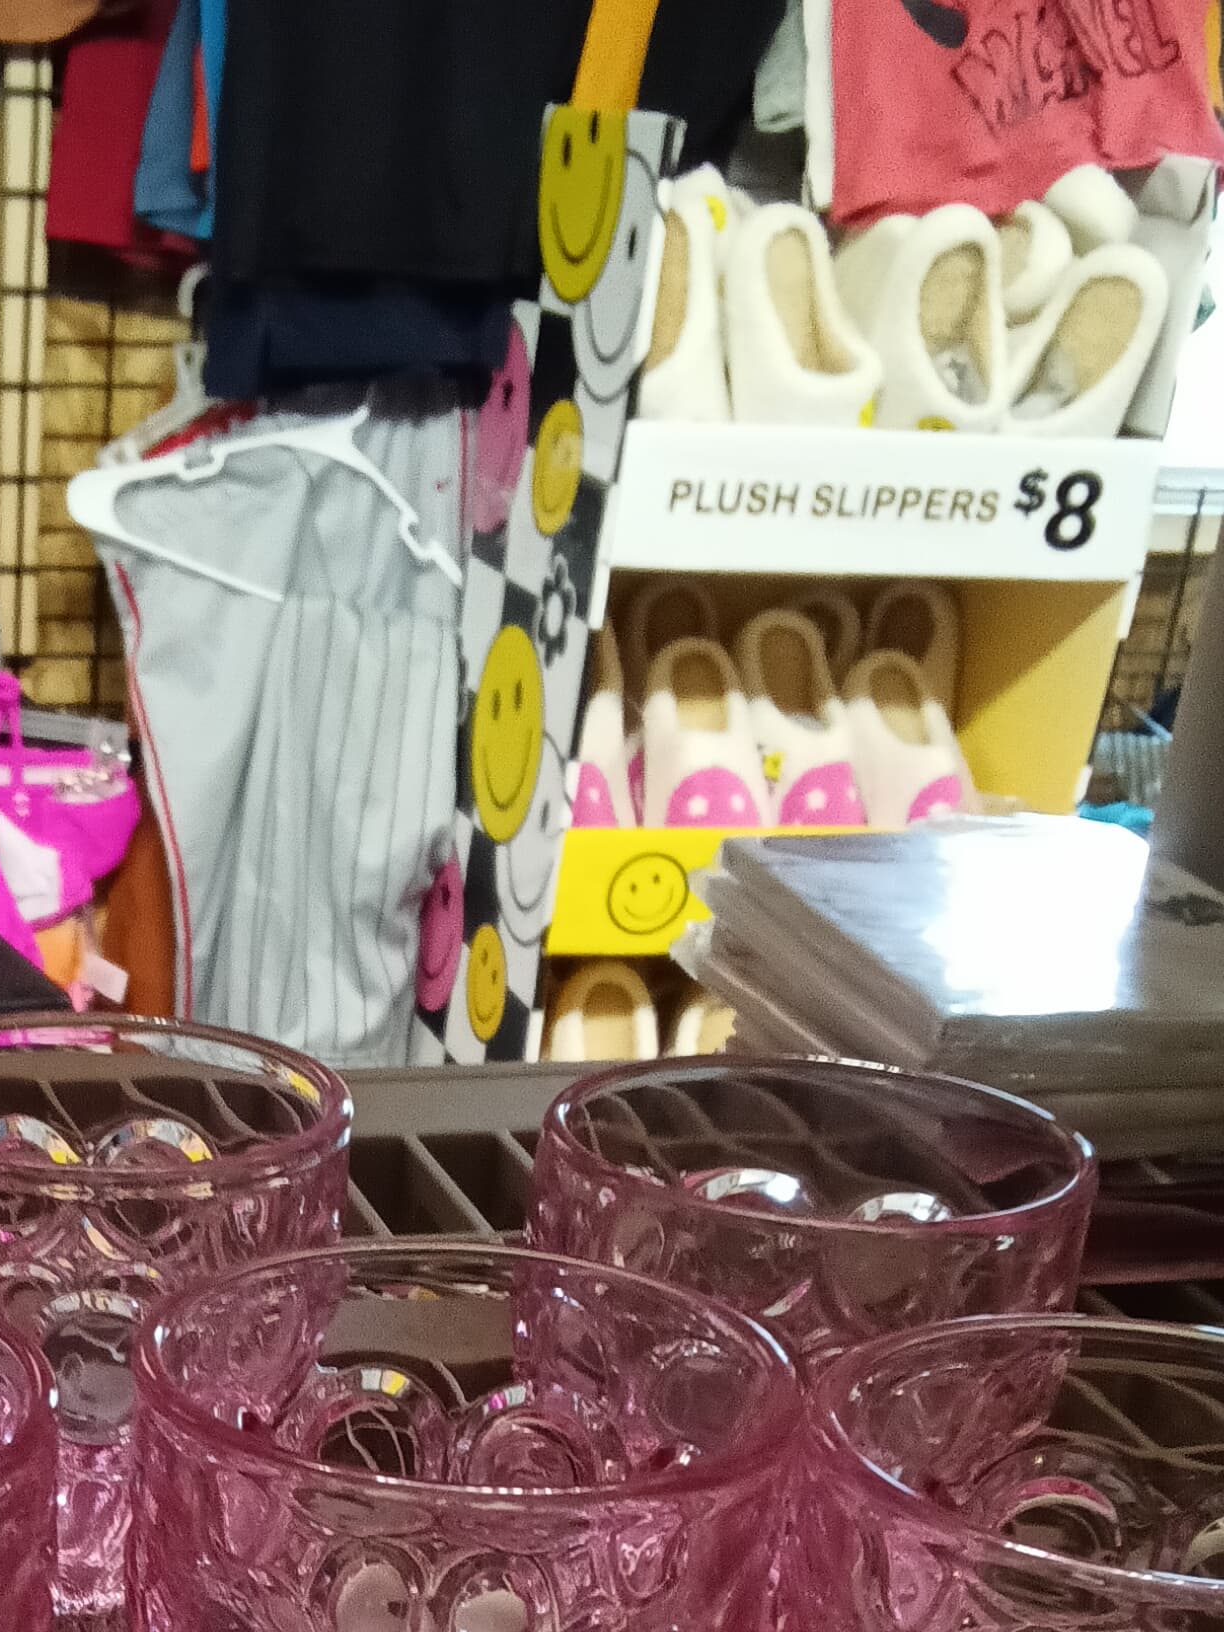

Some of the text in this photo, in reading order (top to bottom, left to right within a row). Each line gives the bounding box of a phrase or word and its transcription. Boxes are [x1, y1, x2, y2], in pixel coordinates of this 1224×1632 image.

[669, 467, 1104, 551] PLUSH SLIPPERS $8
